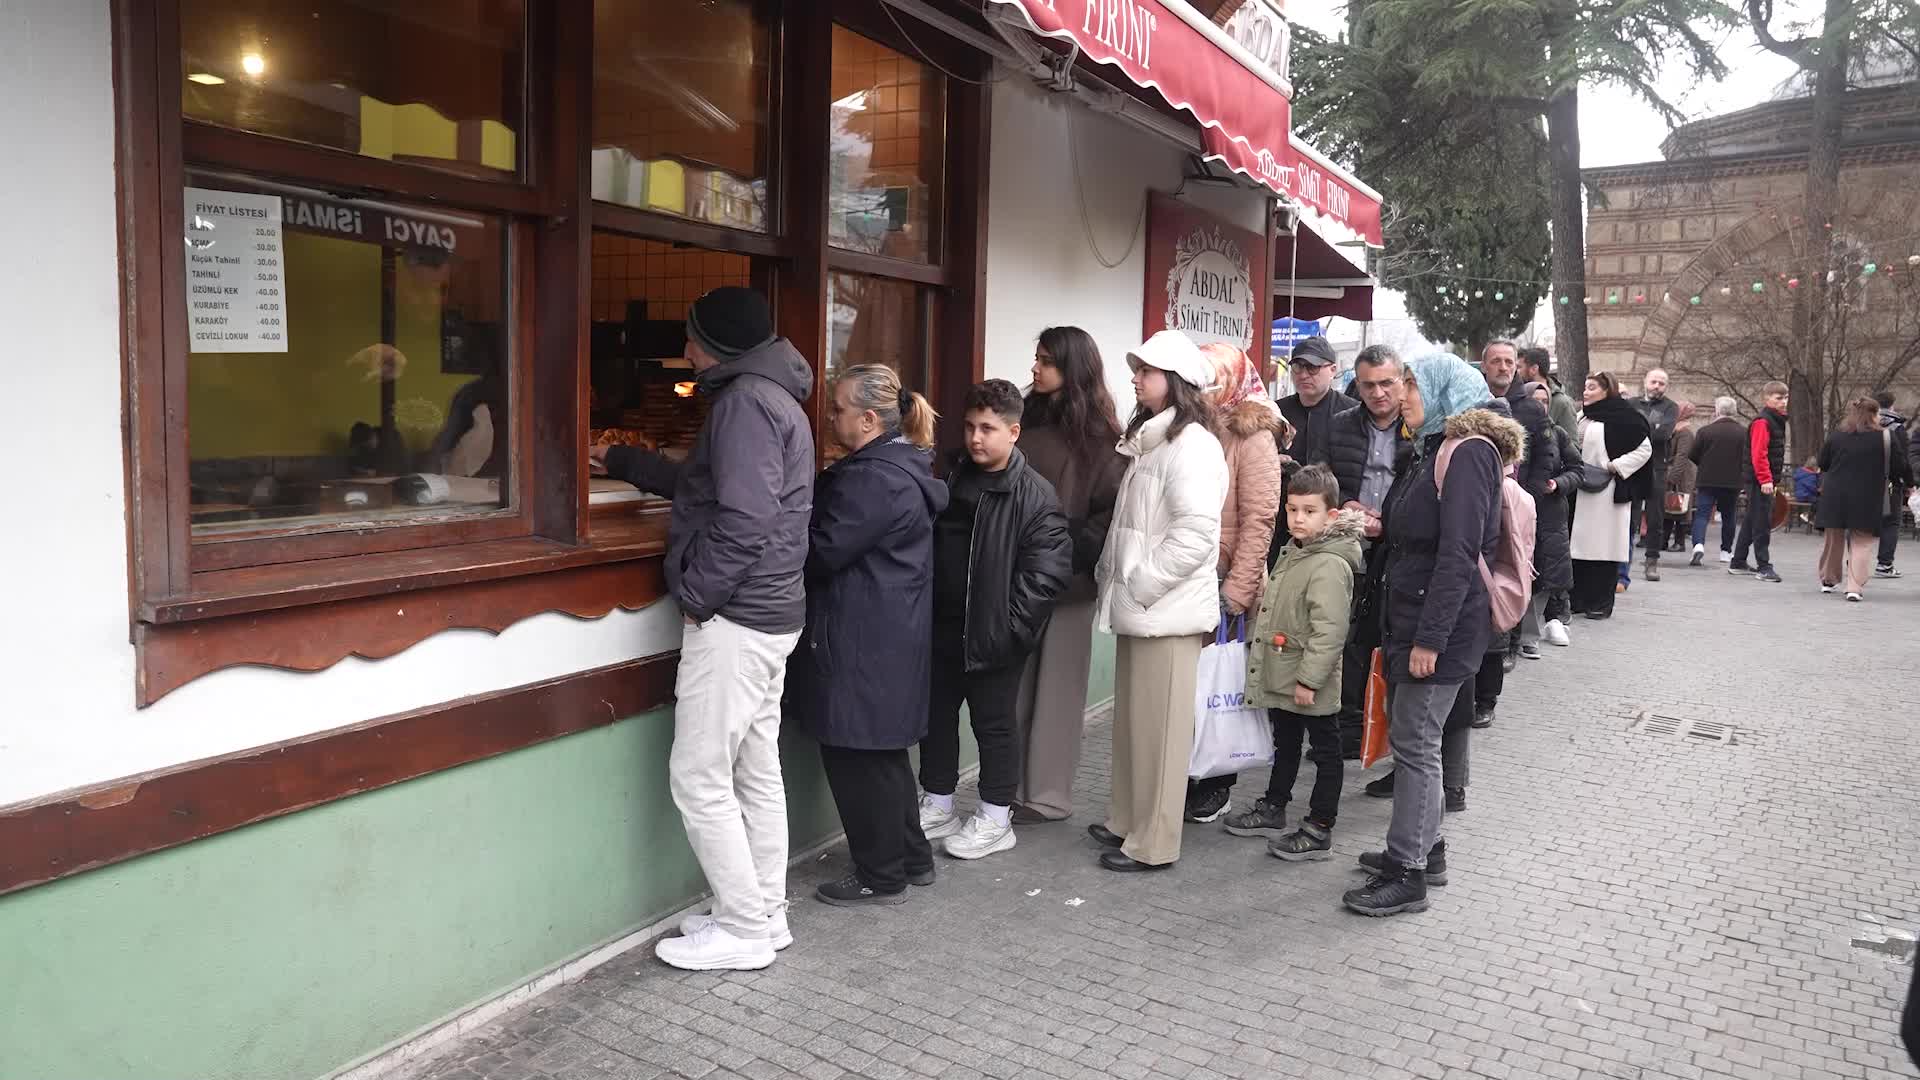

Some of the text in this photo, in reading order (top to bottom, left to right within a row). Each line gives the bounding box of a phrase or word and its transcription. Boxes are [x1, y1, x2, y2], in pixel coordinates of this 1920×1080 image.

[196, 202, 268, 218] FİYAT LİSTESİ
[1327, 179, 1350, 221] FIRINI
[224, 287, 239, 295] KEK
[1180, 303, 1243, 338] SİMİT FIRINI
